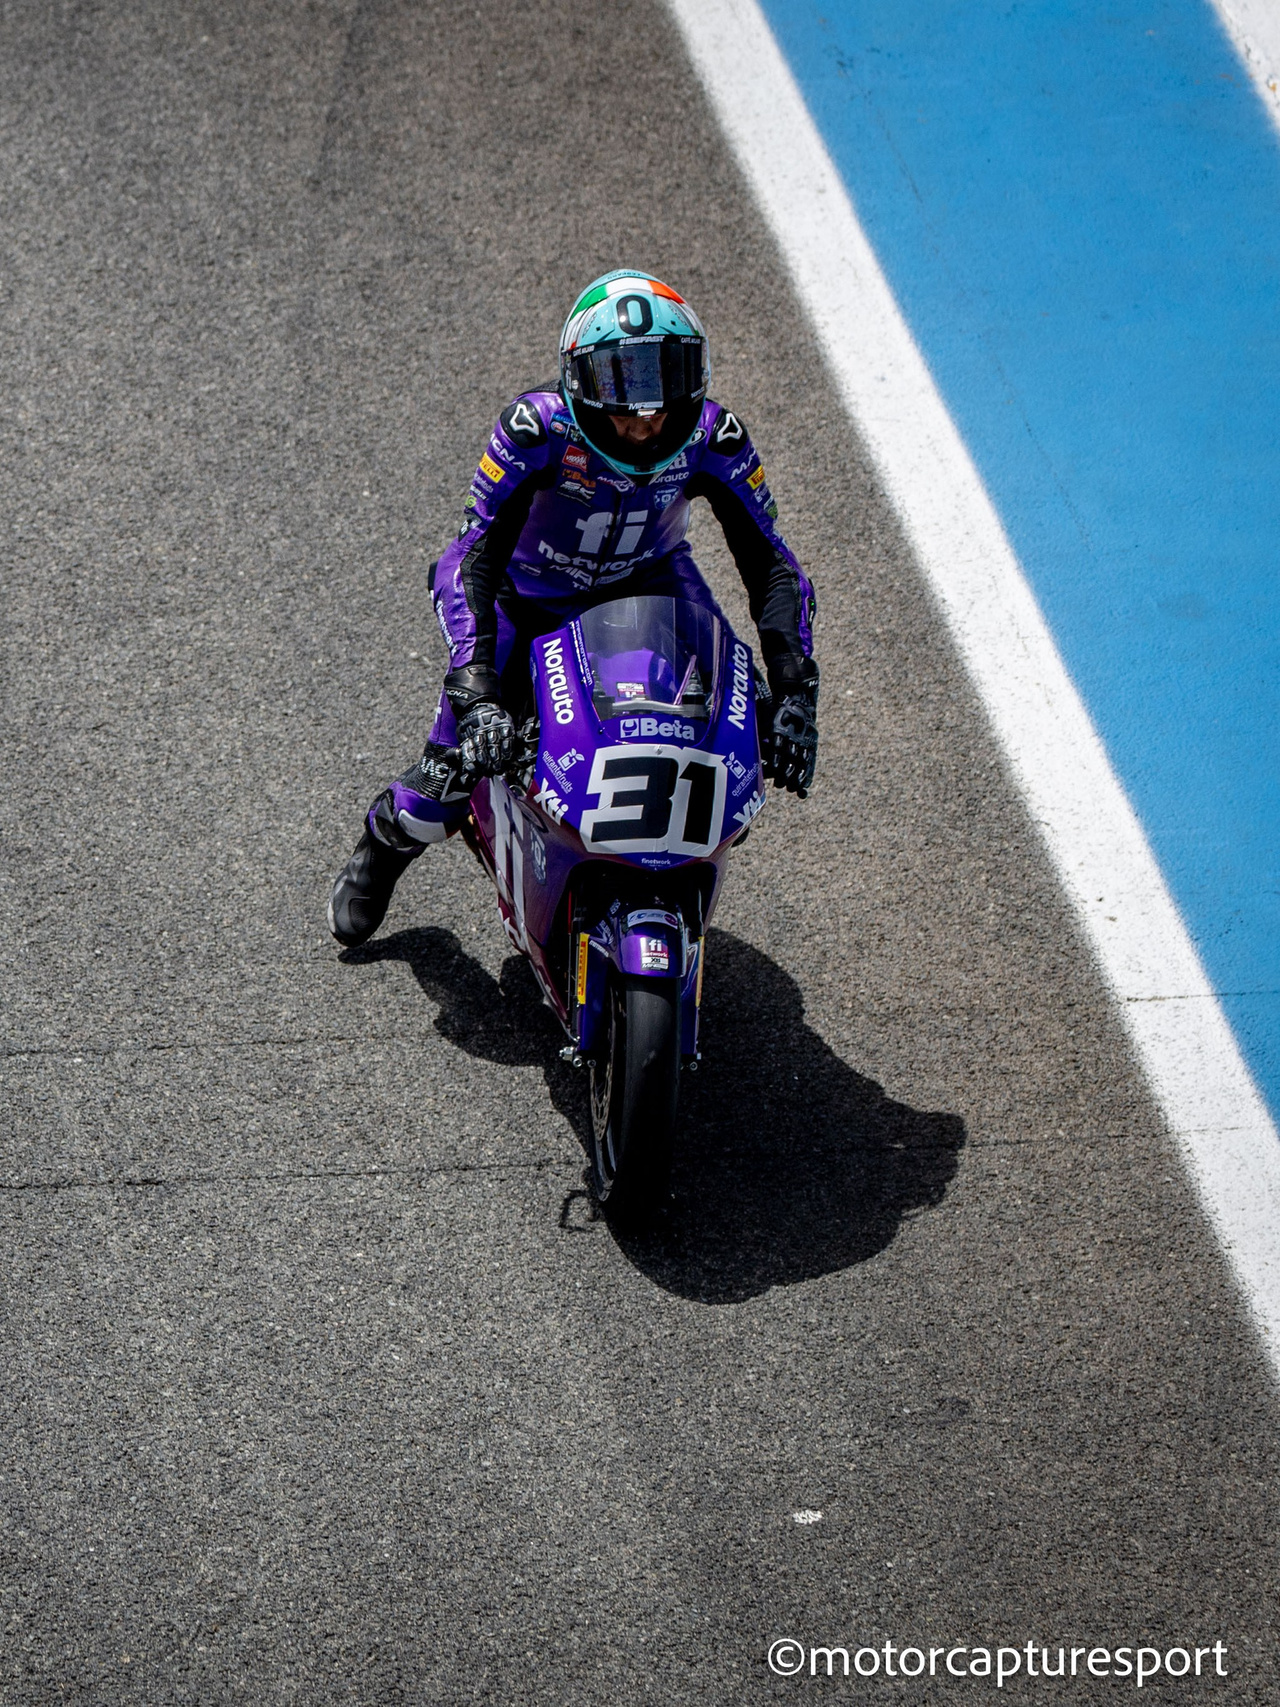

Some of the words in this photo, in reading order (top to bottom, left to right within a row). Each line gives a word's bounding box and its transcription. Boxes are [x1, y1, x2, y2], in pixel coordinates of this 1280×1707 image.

[616, 295, 653, 335] 0
[655, 471, 690, 484] orauto
[538, 540, 656, 573] network
[543, 637, 574, 725] Norauto
[728, 643, 749, 731] Norauto
[640, 718, 695, 740] Beta
[542, 750, 573, 793] quirantefruits
[533, 777, 569, 826] Xti
[591, 757, 717, 846] 31
[641, 858, 671, 866] finetwork
[648, 939, 662, 951] fi
